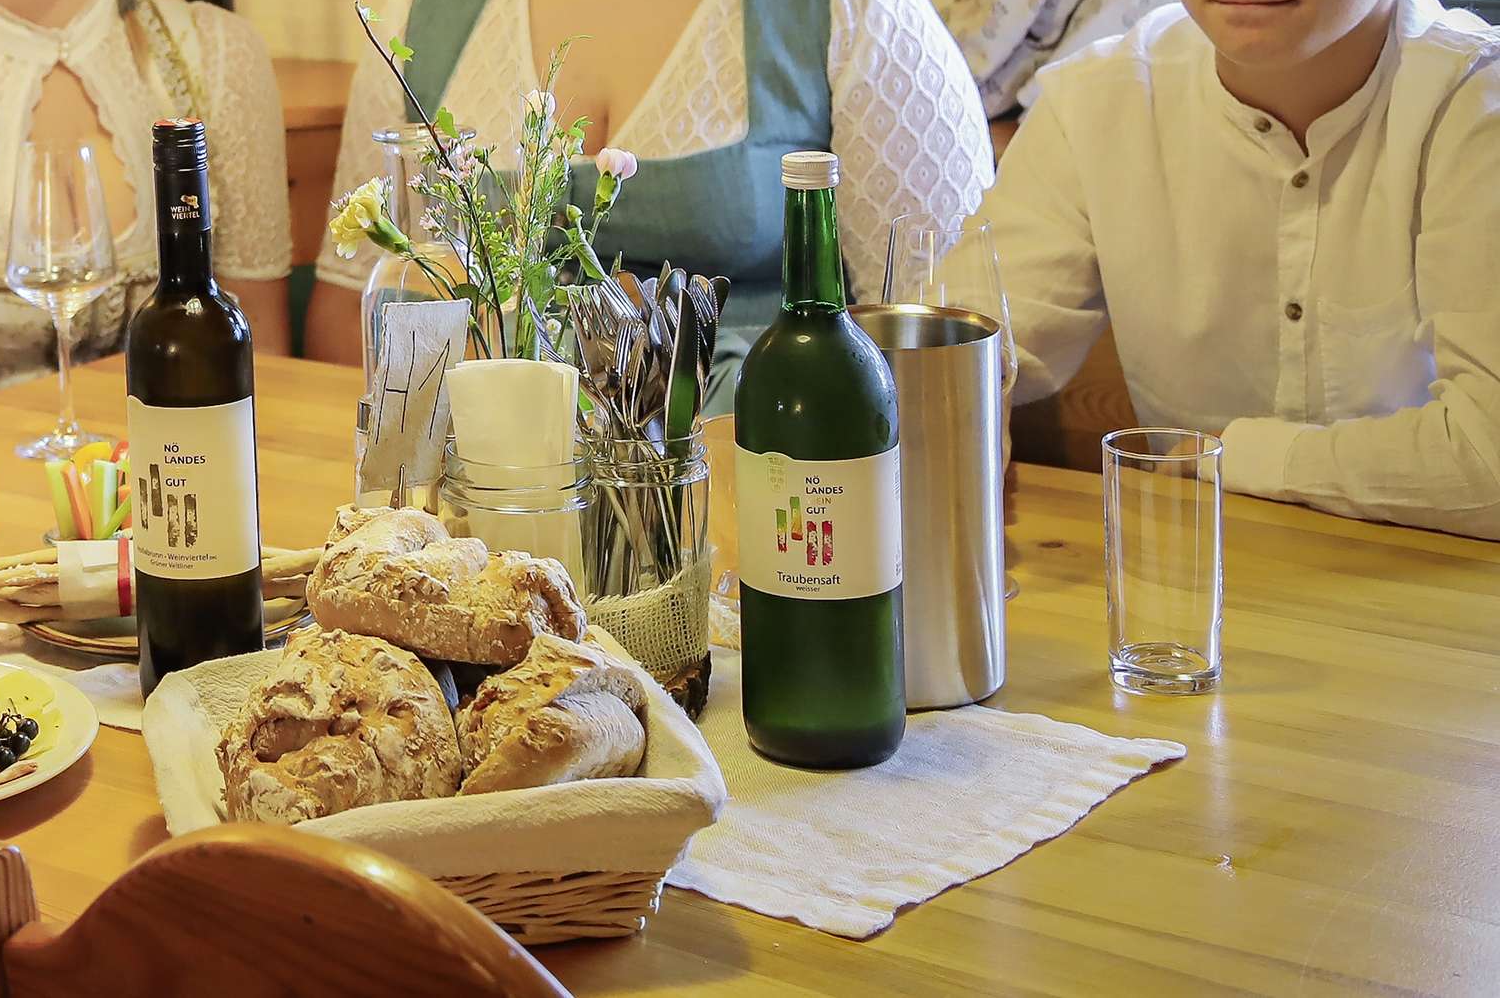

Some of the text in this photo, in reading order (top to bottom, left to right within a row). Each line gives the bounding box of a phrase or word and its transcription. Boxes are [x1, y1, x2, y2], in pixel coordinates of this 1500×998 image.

[171, 211, 200, 219] VIERTEL
[164, 442, 179, 453] NÖ
[164, 455, 206, 465] LANDES
[165, 477, 187, 488] GUT
[805, 475, 820, 484] NÖ
[805, 486, 844, 495] LANDES
[806, 506, 827, 515] GUT
[166, 552, 209, 562] Weinviertel
[776, 570, 841, 586] Traubensaft
[795, 585, 821, 593] weisser
